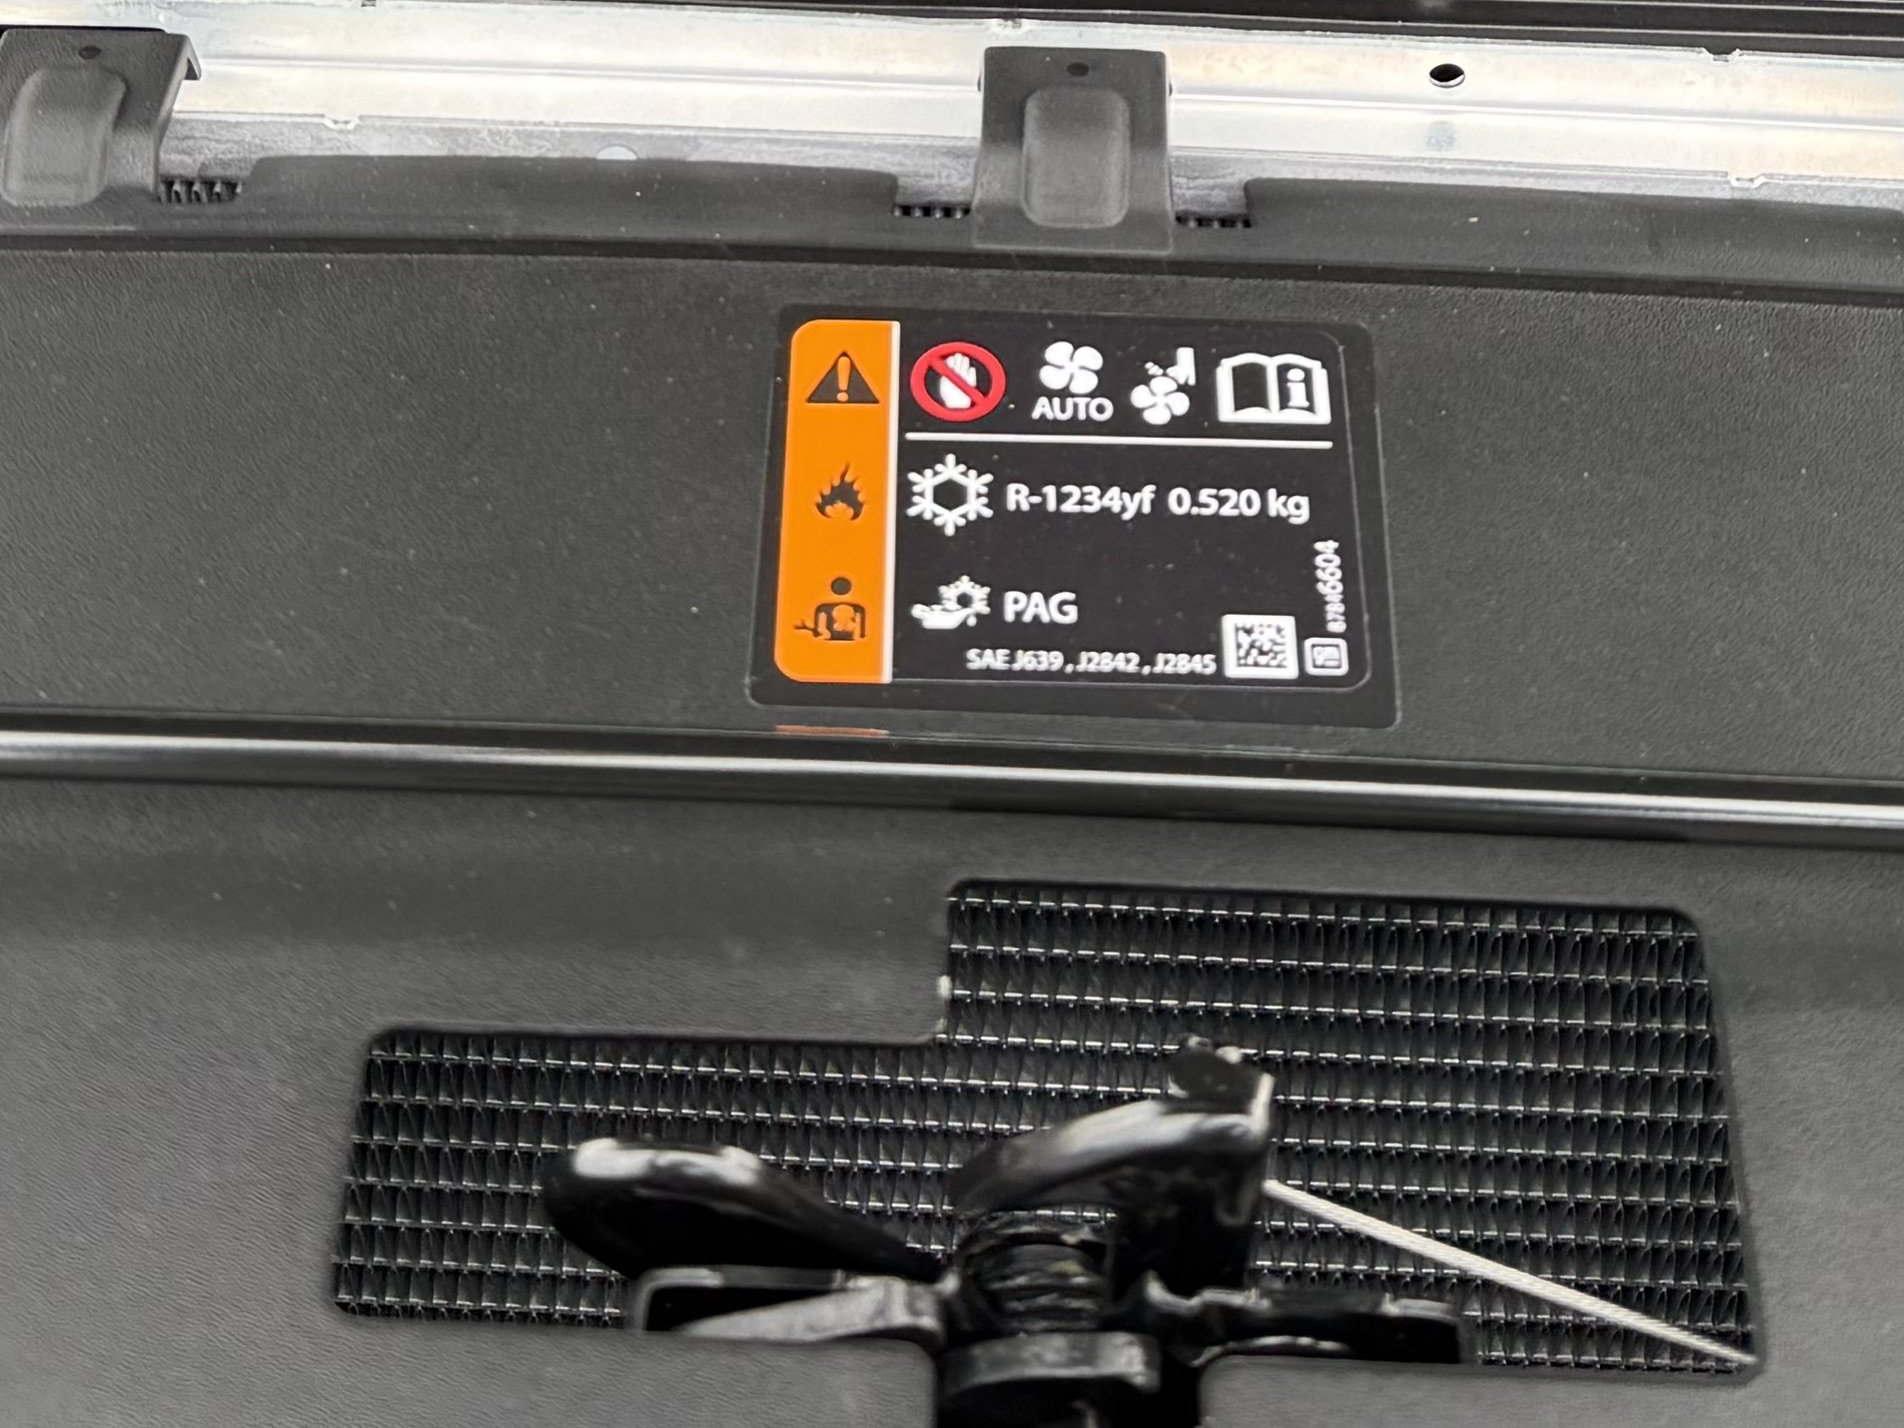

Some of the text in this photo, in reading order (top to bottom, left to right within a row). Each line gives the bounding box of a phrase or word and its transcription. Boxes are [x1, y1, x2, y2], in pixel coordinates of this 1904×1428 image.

[1032, 396, 1114, 422] AUTO
[1006, 483, 1310, 525] R-1234yf 0.520 kg
[1003, 590, 1078, 624] PAG
[966, 648, 1010, 671] SAE
[1152, 653, 1216, 675] J2845
